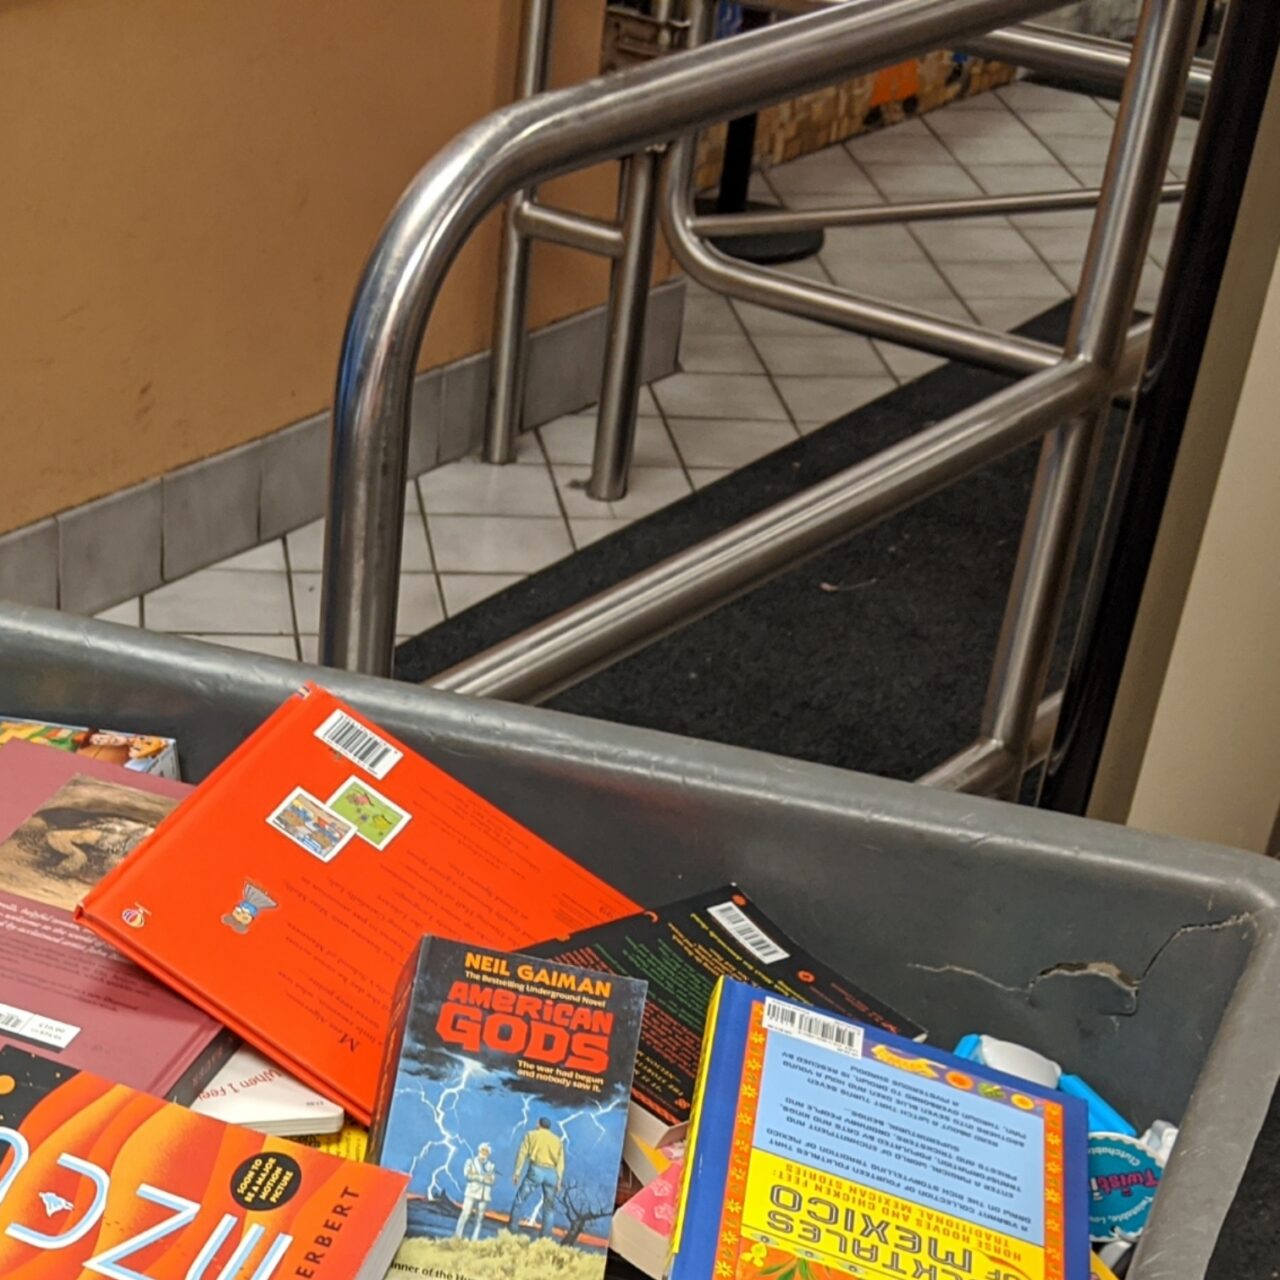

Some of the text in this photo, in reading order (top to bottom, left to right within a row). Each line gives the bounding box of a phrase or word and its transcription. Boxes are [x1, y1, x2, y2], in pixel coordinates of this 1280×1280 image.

[464, 952, 611, 998] NEIL GAIMAN
[464, 971, 606, 1008] The Bestselling Underground Novel
[436, 1001, 610, 1073] GODS
[516, 1067, 601, 1093] and nobody saw it.
[517, 1059, 603, 1086] The war had begun
[768, 1137, 793, 1151] THAT
[795, 1146, 849, 1170] FOLKTALES
[237, 1158, 263, 1194] SOON TO
[244, 1190, 254, 1203] BE
[258, 1157, 277, 1185] MAJOR
[259, 1166, 283, 1201] MOTION
[270, 1171, 294, 1204] PICTURE
[903, 1184, 914, 1193] OF
[771, 1167, 1021, 1261] HORSE HOOVES AND CHICKEN FEET:
[785, 1162, 1009, 1246] TRADITIONAL MEXICAN STORIES
[768, 1182, 972, 1273] MEXICO
[390, 1260, 419, 1274] inner
[422, 1266, 433, 1277] of
